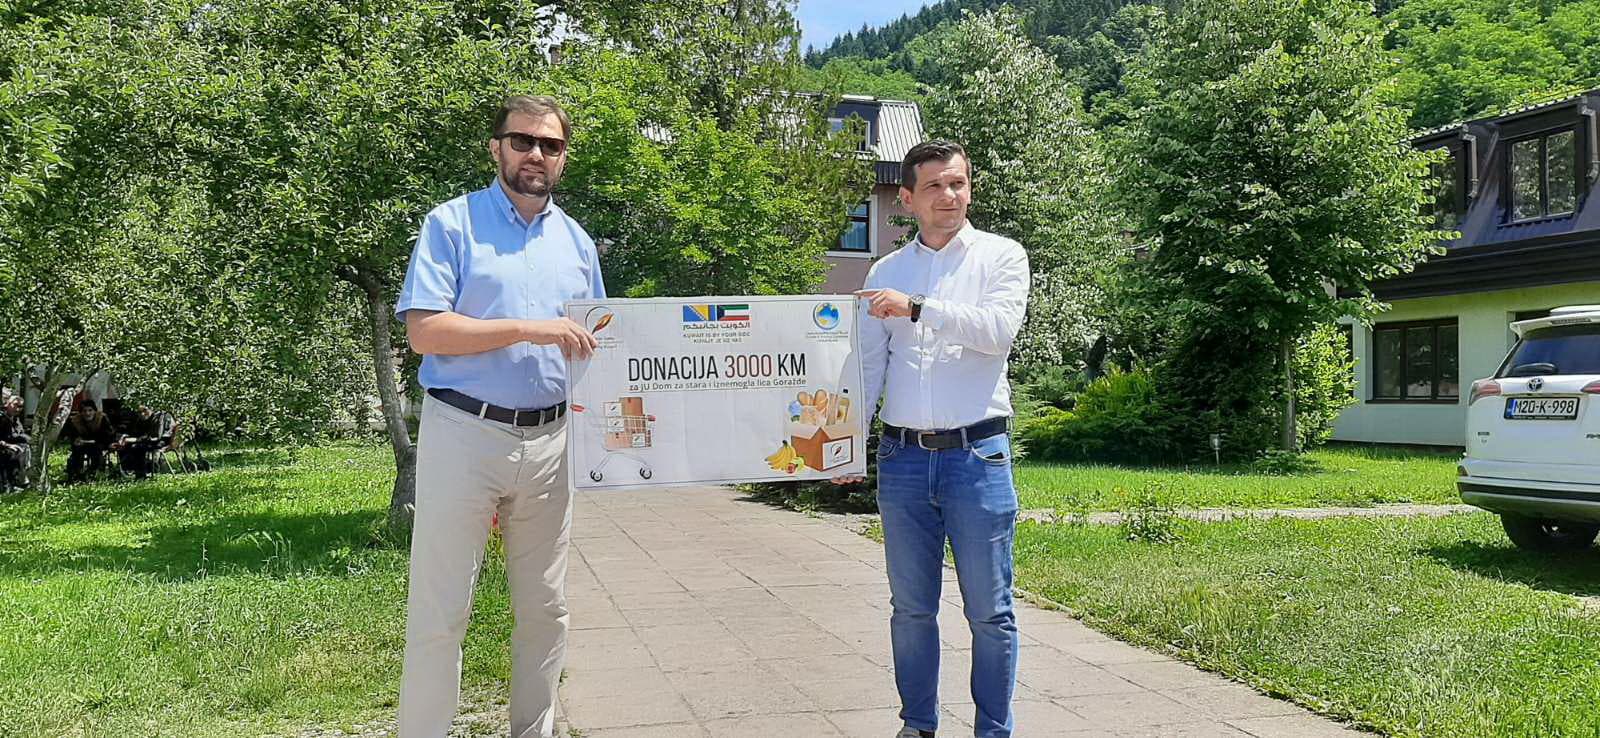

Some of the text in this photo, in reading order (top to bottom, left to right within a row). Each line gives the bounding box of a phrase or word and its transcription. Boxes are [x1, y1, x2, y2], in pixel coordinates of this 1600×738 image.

[628, 353, 806, 381] DONACIJA 3000 KM
[653, 382, 672, 391] Dom
[685, 381, 707, 389] stara
[713, 379, 755, 390] iznemogla
[757, 378, 772, 387] lica
